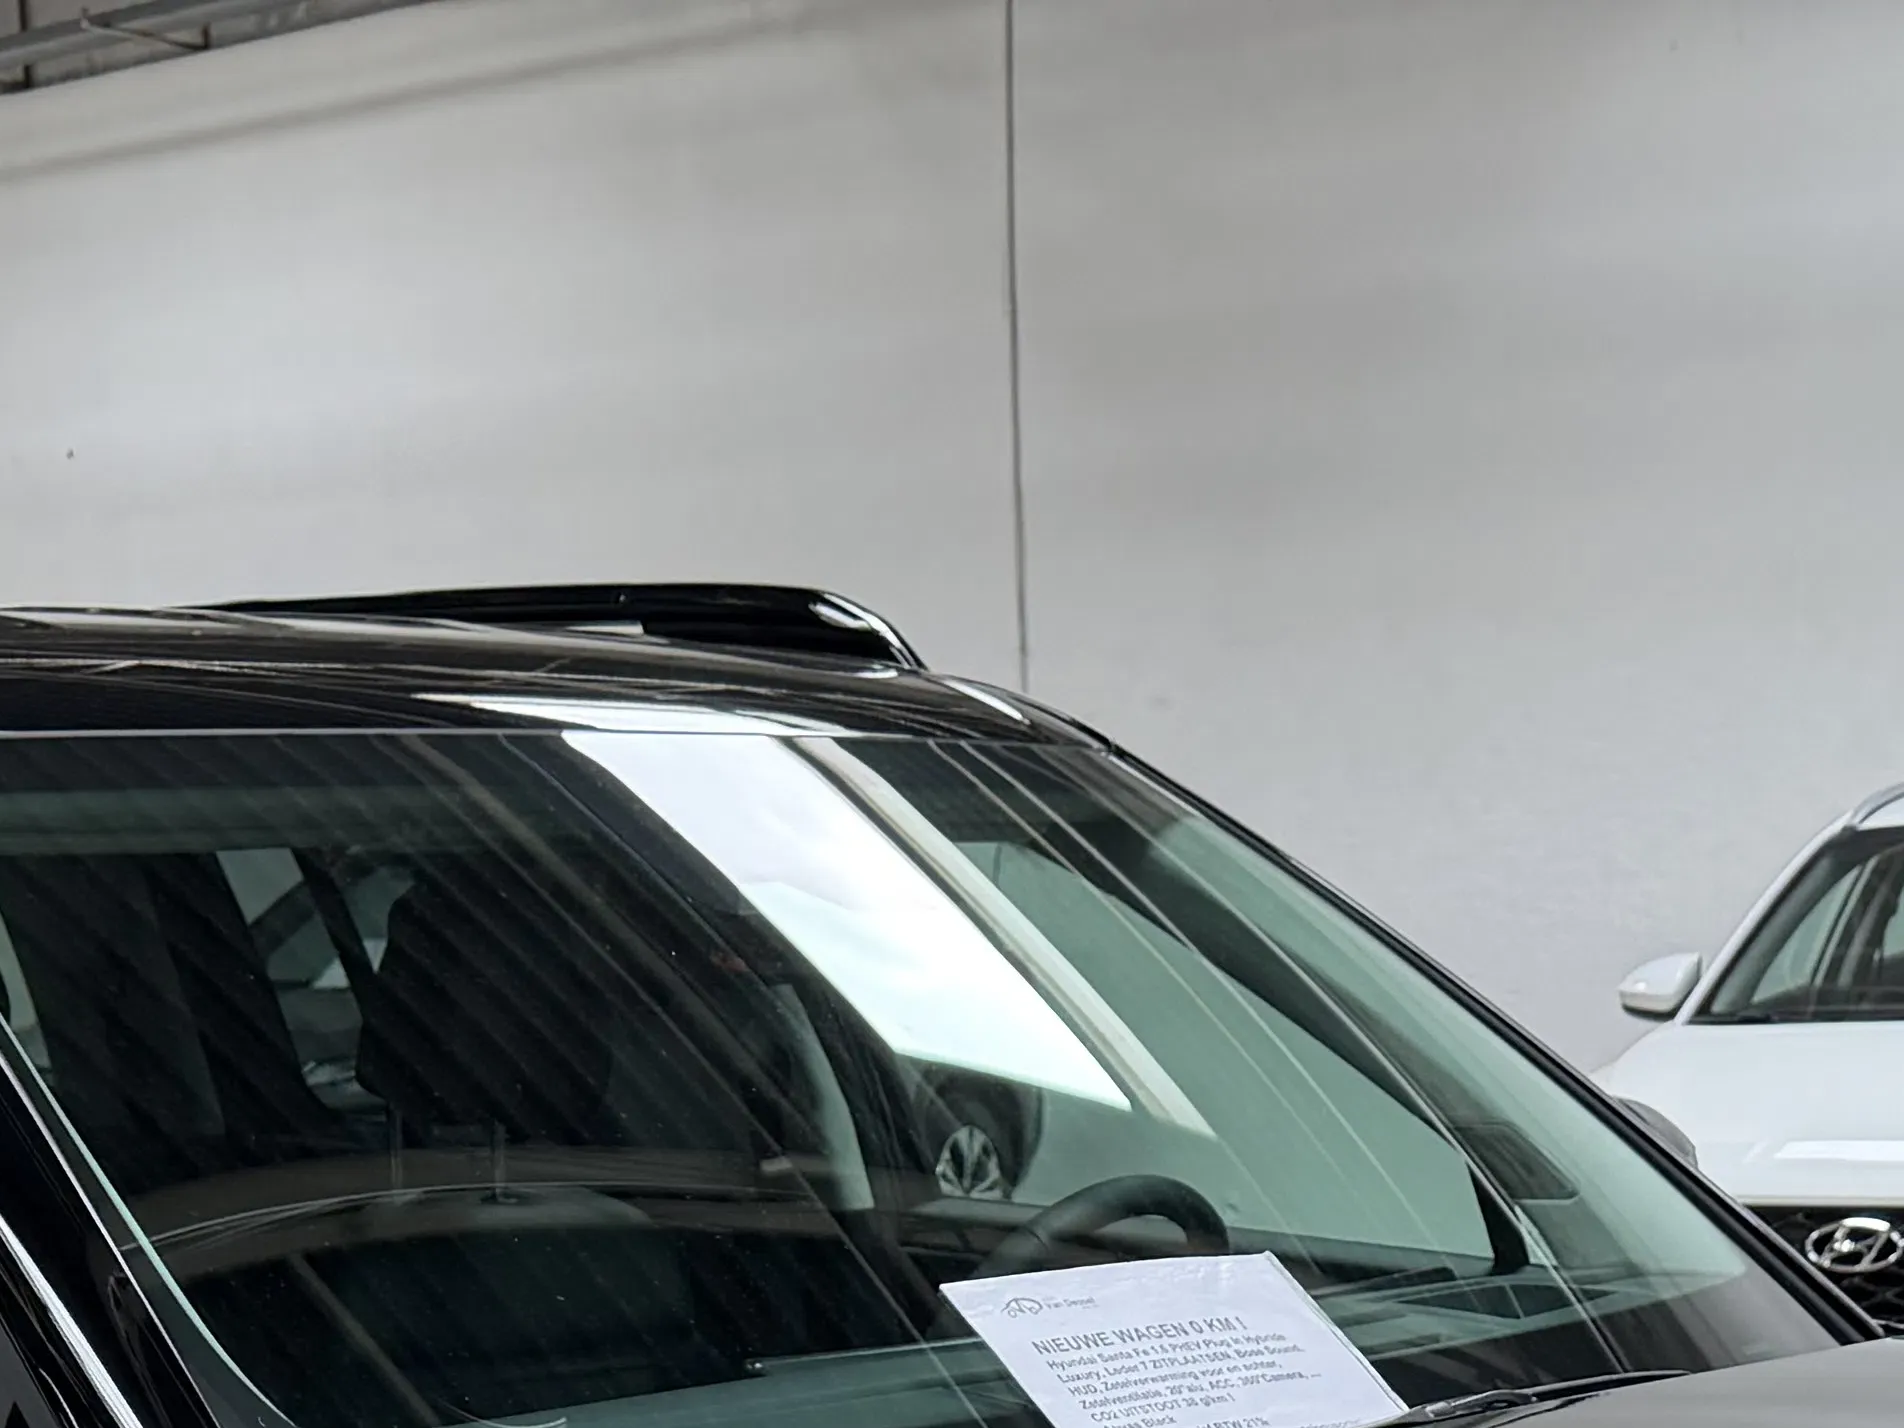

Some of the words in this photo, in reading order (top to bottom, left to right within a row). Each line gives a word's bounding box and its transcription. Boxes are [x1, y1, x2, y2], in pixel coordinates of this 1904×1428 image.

[1031, 1332, 1114, 1354] NIEUWE
[1112, 1322, 1189, 1343] WAGEN
[1188, 1320, 1206, 1333] 0
[1203, 1317, 1237, 1331] KM
[1047, 1356, 1097, 1370] Hyundai
[1098, 1351, 1133, 1361] Santa
[1168, 1341, 1200, 1351] PHEV
[1104, 1365, 1139, 1374] Leder
[1118, 1399, 1182, 1416] UITSTOOT
[1141, 1416, 1176, 1427] Black
